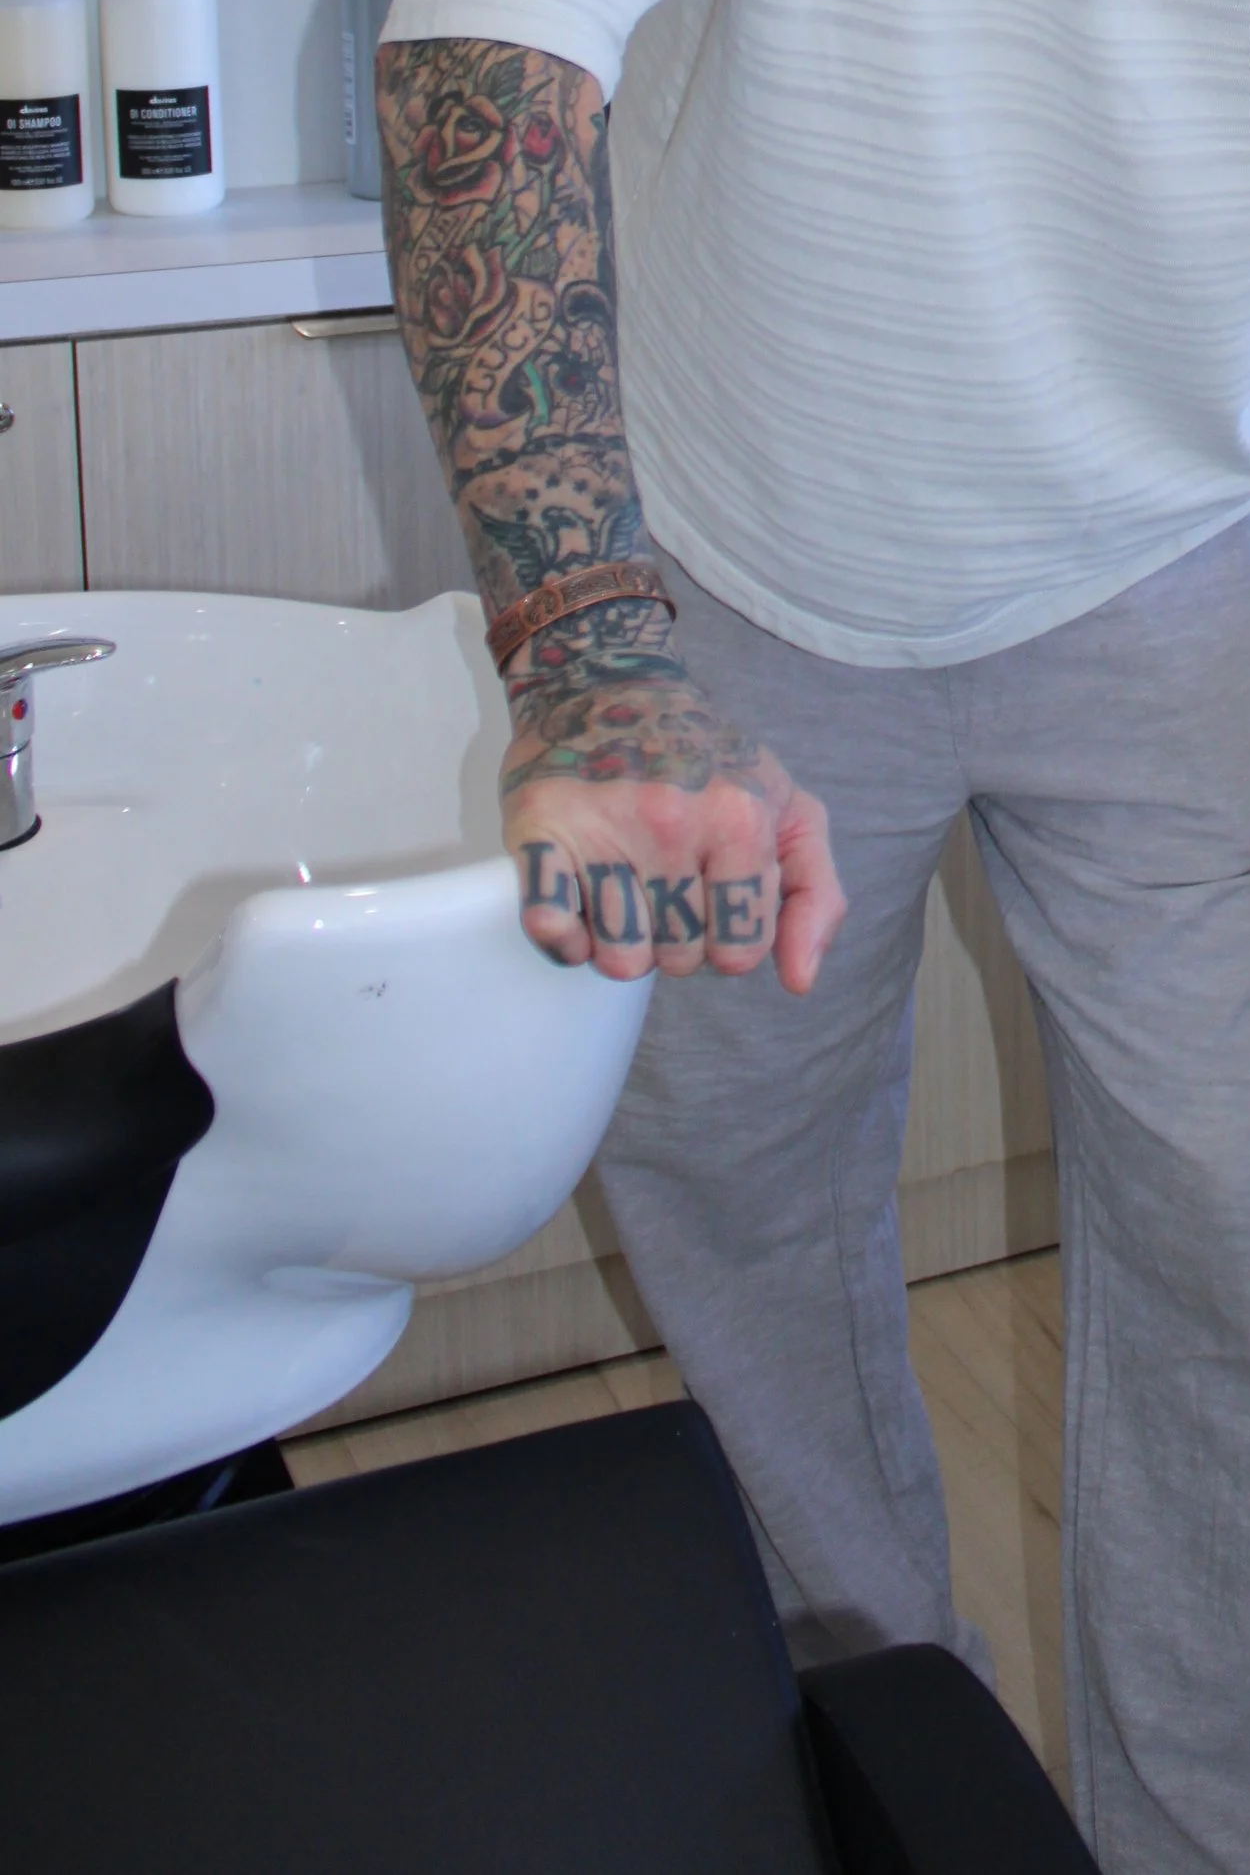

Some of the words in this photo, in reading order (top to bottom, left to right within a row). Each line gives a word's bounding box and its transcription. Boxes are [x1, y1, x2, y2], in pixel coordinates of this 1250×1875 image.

[140, 105, 198, 119] CONDITIONER
[18, 116, 62, 130] SHAMPOO
[519, 841, 764, 946] LUKE
